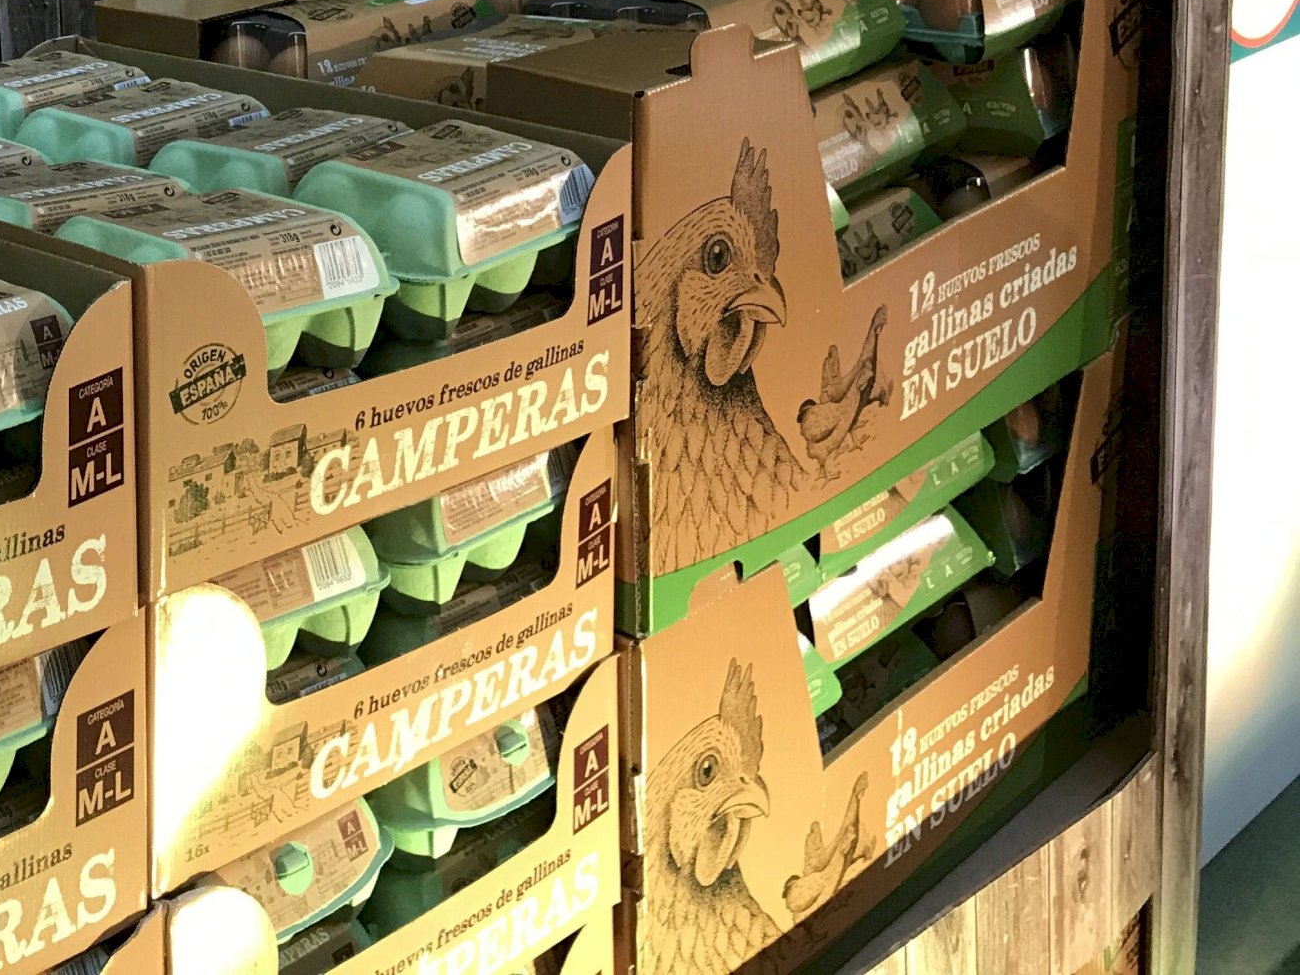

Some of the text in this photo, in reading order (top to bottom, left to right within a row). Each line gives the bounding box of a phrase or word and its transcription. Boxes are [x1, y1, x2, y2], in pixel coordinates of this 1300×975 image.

[418, 142, 533, 182] CAMPERAS
[601, 238, 613, 266] A
[908, 232, 1041, 322] 12 HUEVOS FRESCOS
[589, 283, 621, 320] M-L
[903, 244, 1078, 376] gallinas criadas
[184, 349, 226, 379] ORIGEN
[900, 307, 1037, 421] EN SUELO
[78, 376, 114, 400] CATEGORÍA
[179, 366, 236, 407] ESPAÑA
[355, 339, 584, 431] 6 huevos frescos de gallinas
[87, 398, 107, 433] A
[202, 400, 228, 420] 100%
[86, 440, 107, 456] CLASE
[309, 350, 610, 516] CAMPERAS
[71, 452, 122, 500] M-L
[588, 501, 601, 530] A
[853, 509, 886, 542] SUELO
[577, 552, 608, 585] M-L
[353, 602, 573, 720] 6 huevos frescos de gallinas
[87, 698, 125, 725] CATEGORÍA
[309, 606, 598, 800] CAMPERAS
[919, 703, 968, 755] HUEVOS
[969, 664, 1019, 716] FRESCOS
[980, 665, 1054, 741] criadas
[95, 720, 116, 755] A
[95, 760, 116, 779] CLASE
[584, 749, 599, 778] A
[78, 771, 131, 820] M-L
[574, 788, 608, 830] M-L
[884, 732, 1016, 869] EN SUELO
[346, 822, 355, 835] A
[346, 840, 367, 862] M-L
[415, 853, 598, 975] PERAS
[437, 902, 492, 950] frescos
[495, 887, 513, 910] de
[514, 848, 571, 901] gallinas
